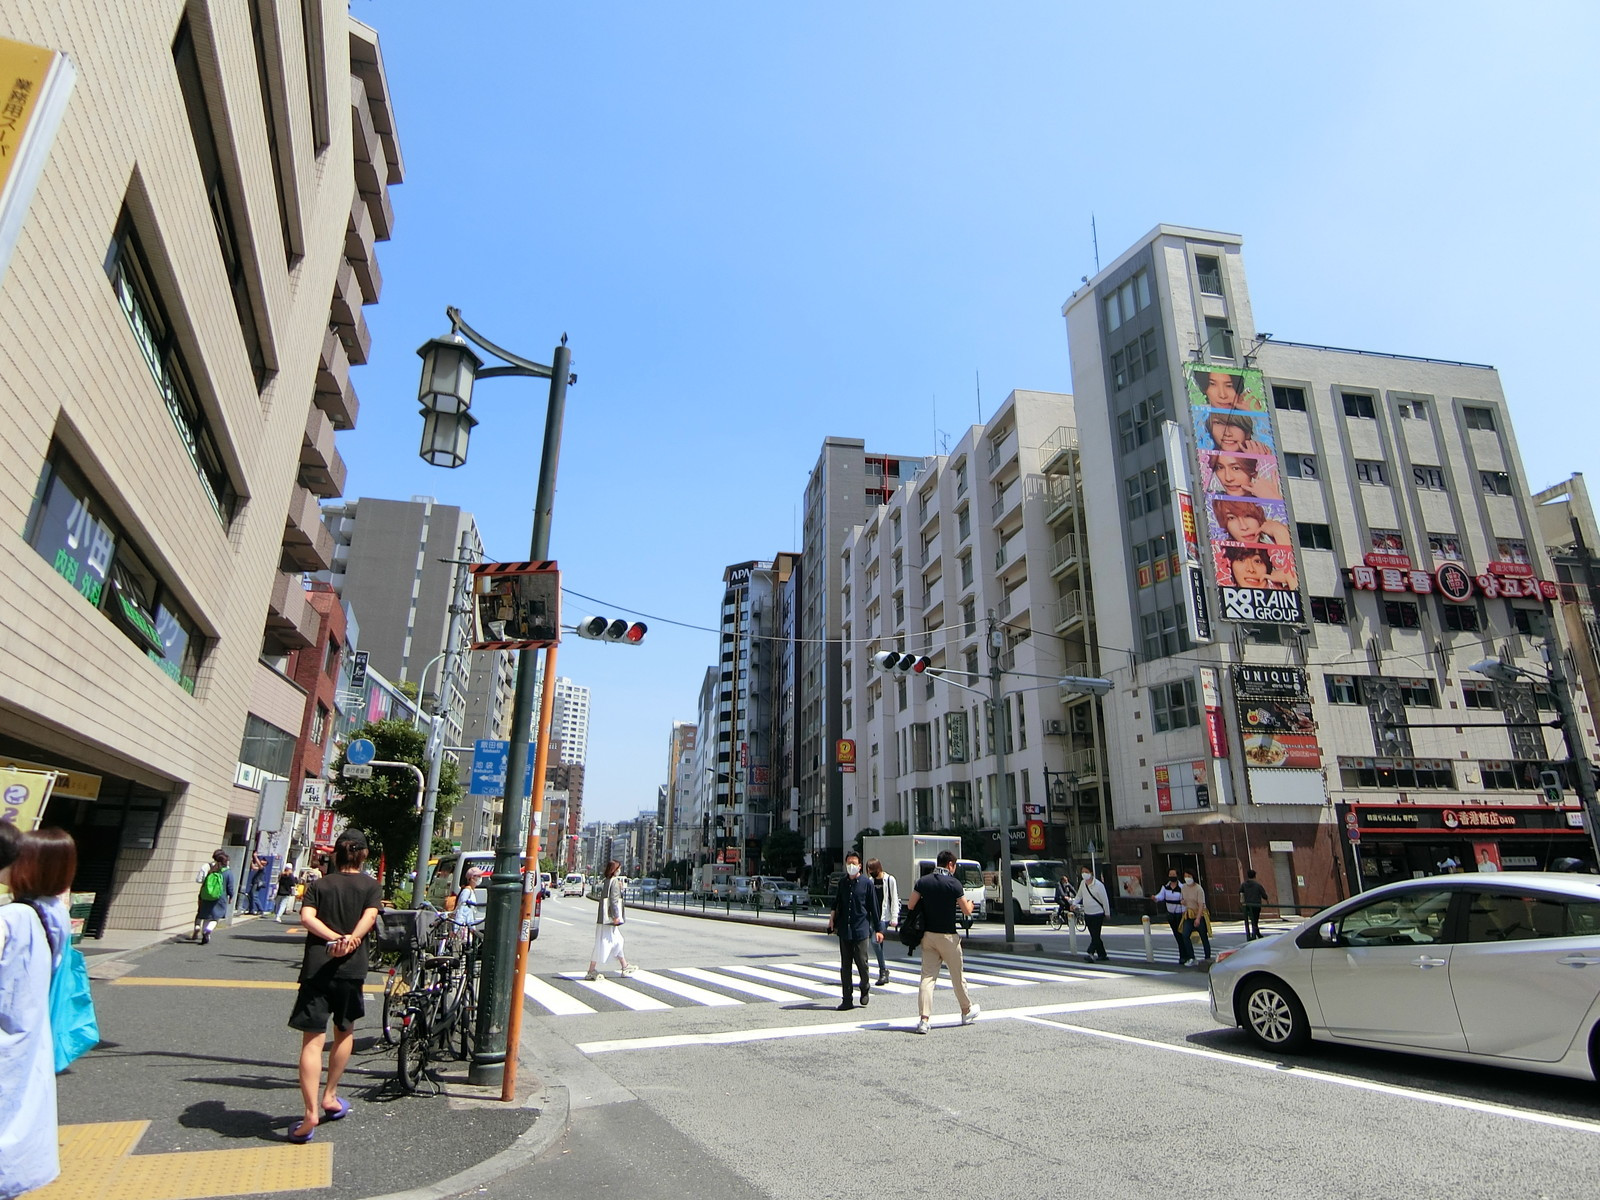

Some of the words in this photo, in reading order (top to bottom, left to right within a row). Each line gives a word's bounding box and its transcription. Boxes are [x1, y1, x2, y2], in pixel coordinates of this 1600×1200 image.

[1183, 510, 1195, 537] 串
[1214, 540, 1245, 548] KAZUYA
[1353, 566, 1431, 592] 阿里香
[1543, 585, 1555, 595] 5F
[1193, 572, 1203, 617] UNIQUE
[1253, 589, 1298, 609] RAIN
[1255, 607, 1299, 621] GROUP
[1242, 670, 1300, 683] UNIQUE
[480, 741, 503, 750] 飯田橋
[475, 761, 494, 770] 池袋
[1458, 811, 1499, 826] 香港飯店
